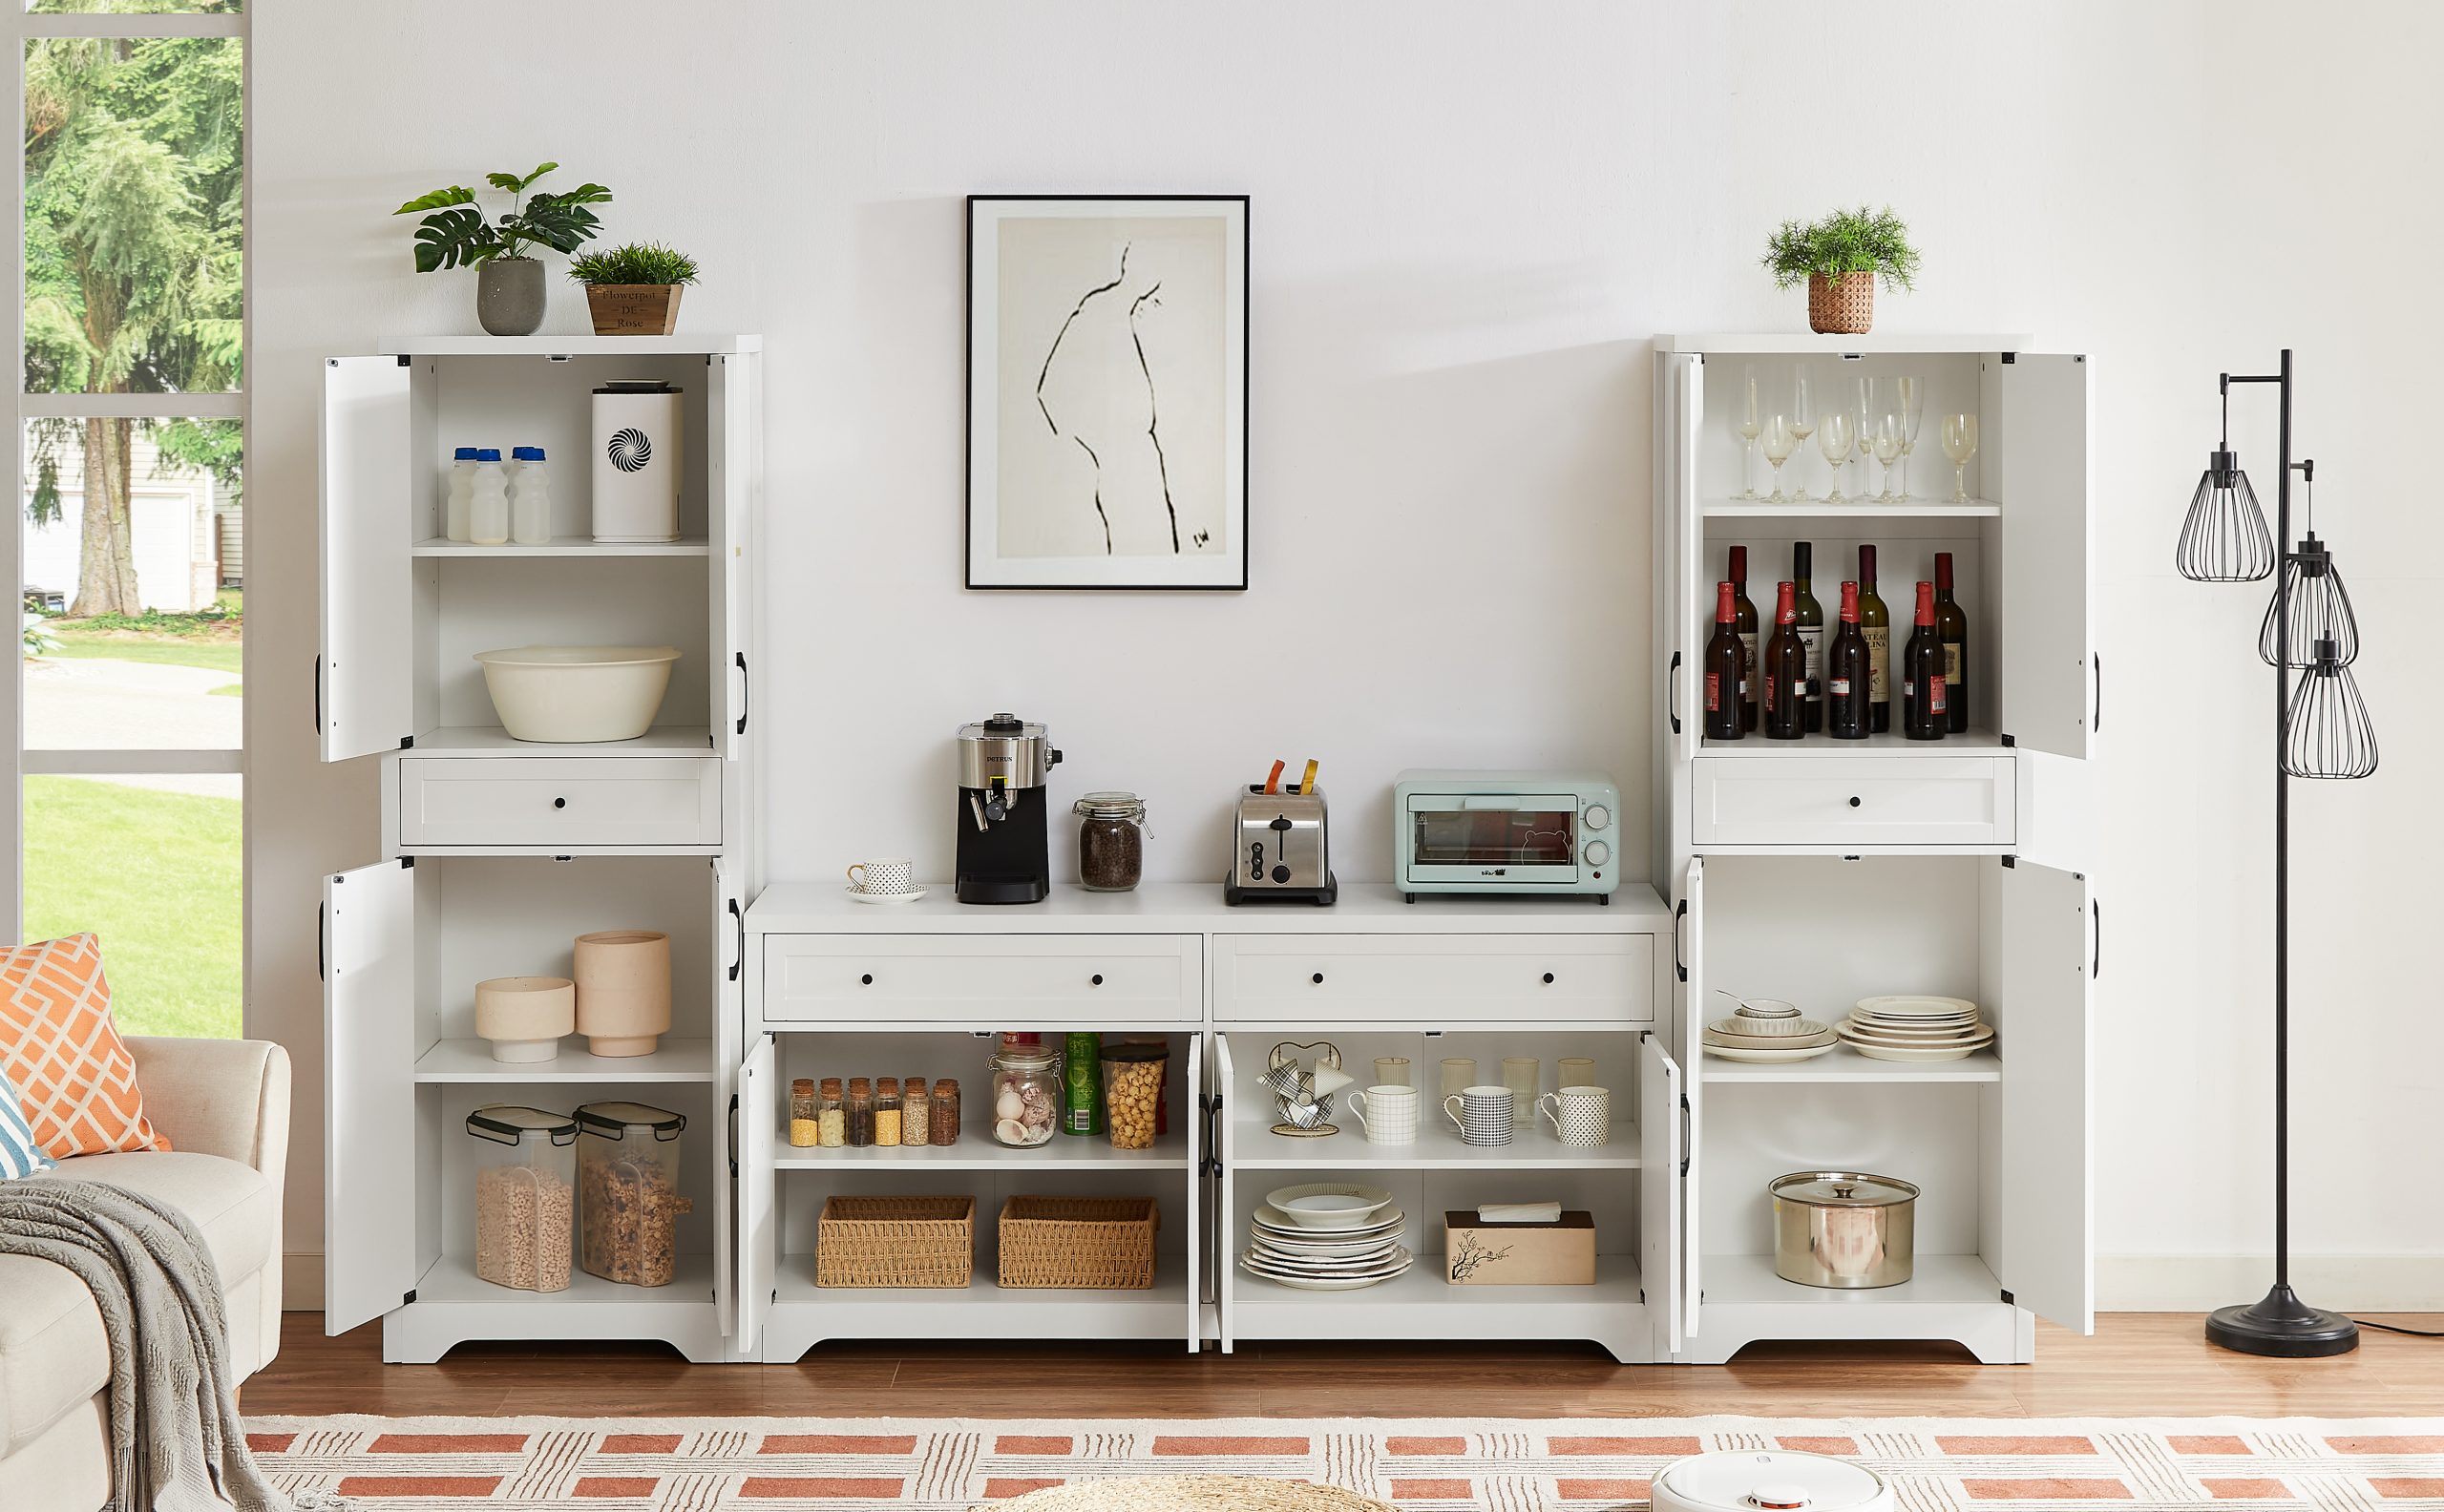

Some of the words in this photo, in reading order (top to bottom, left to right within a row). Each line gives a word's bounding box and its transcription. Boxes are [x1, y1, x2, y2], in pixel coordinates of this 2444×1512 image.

[602, 290, 656, 302] Flowerpot
[622, 305, 638, 315] DE
[618, 319, 643, 327] Rose
